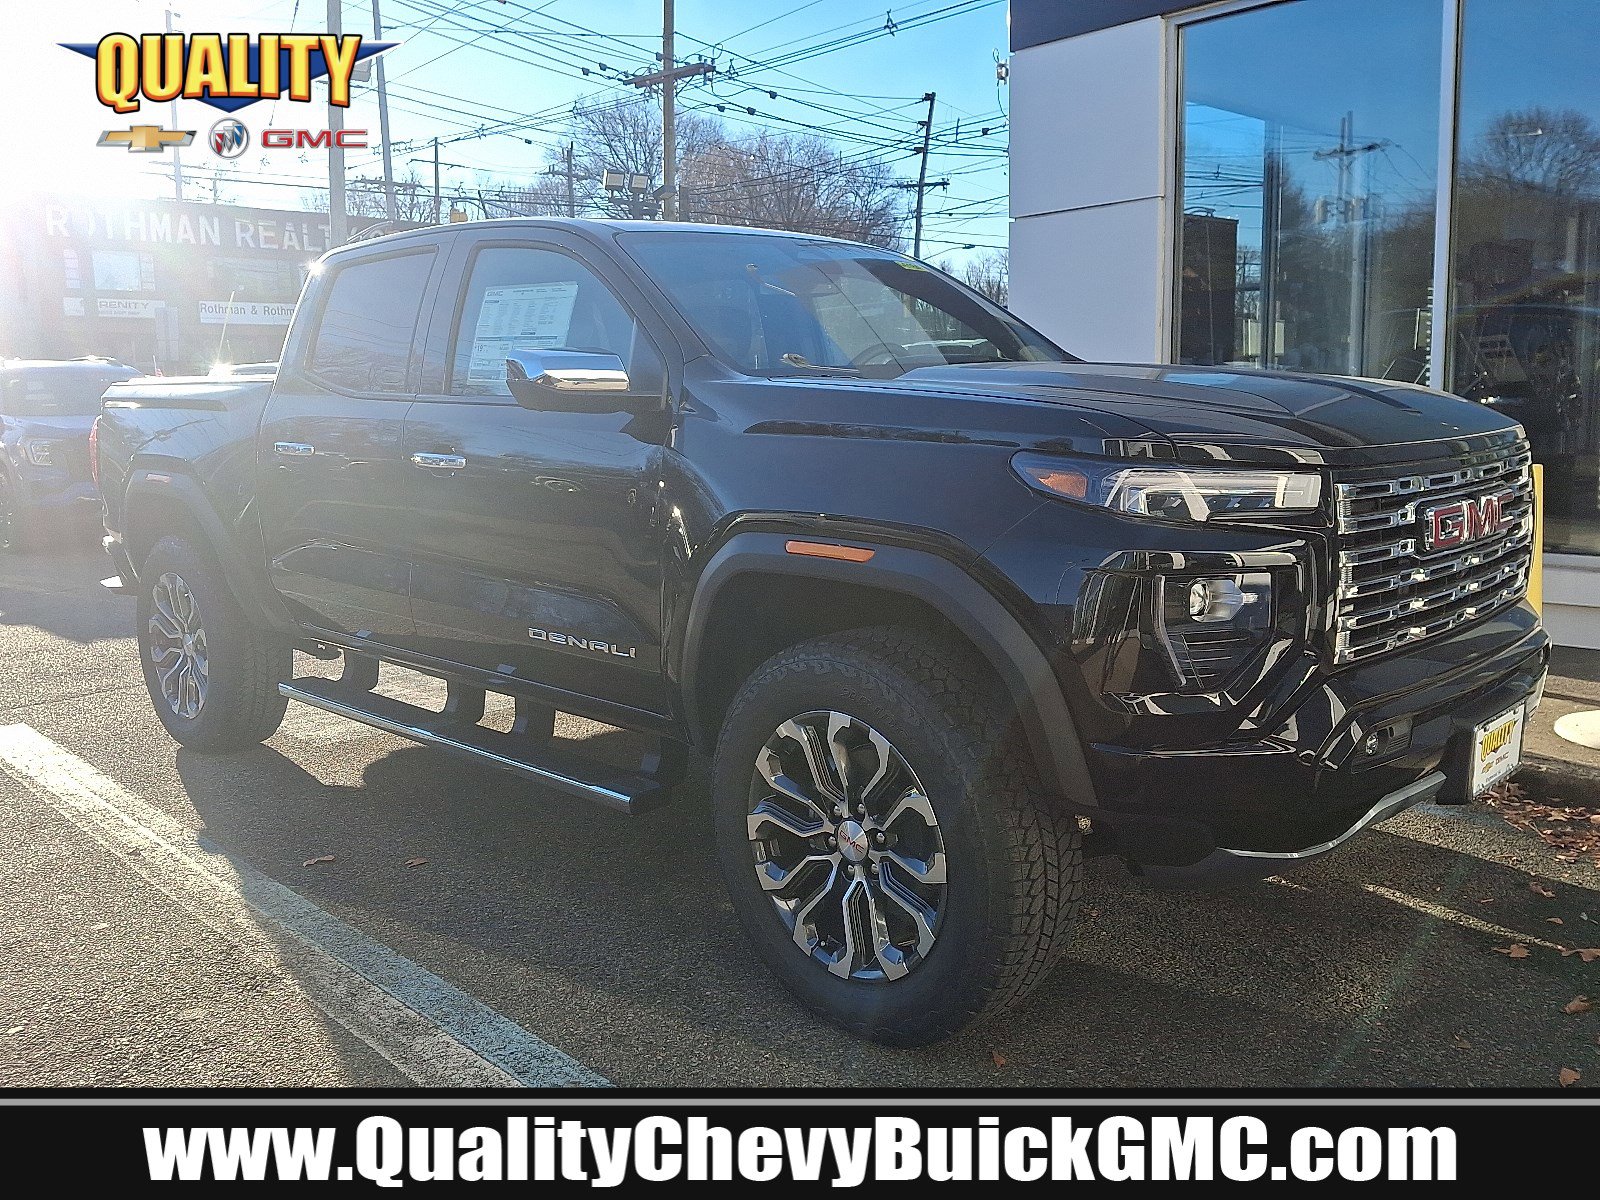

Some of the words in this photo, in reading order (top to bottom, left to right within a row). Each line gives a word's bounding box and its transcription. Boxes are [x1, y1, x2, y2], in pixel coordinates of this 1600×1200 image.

[251, 305, 258, 315] &
[1426, 489, 1515, 548] GMC
[528, 627, 636, 658] DENALI
[1480, 719, 1516, 762] QUALITY
[840, 829, 865, 854] GMC
